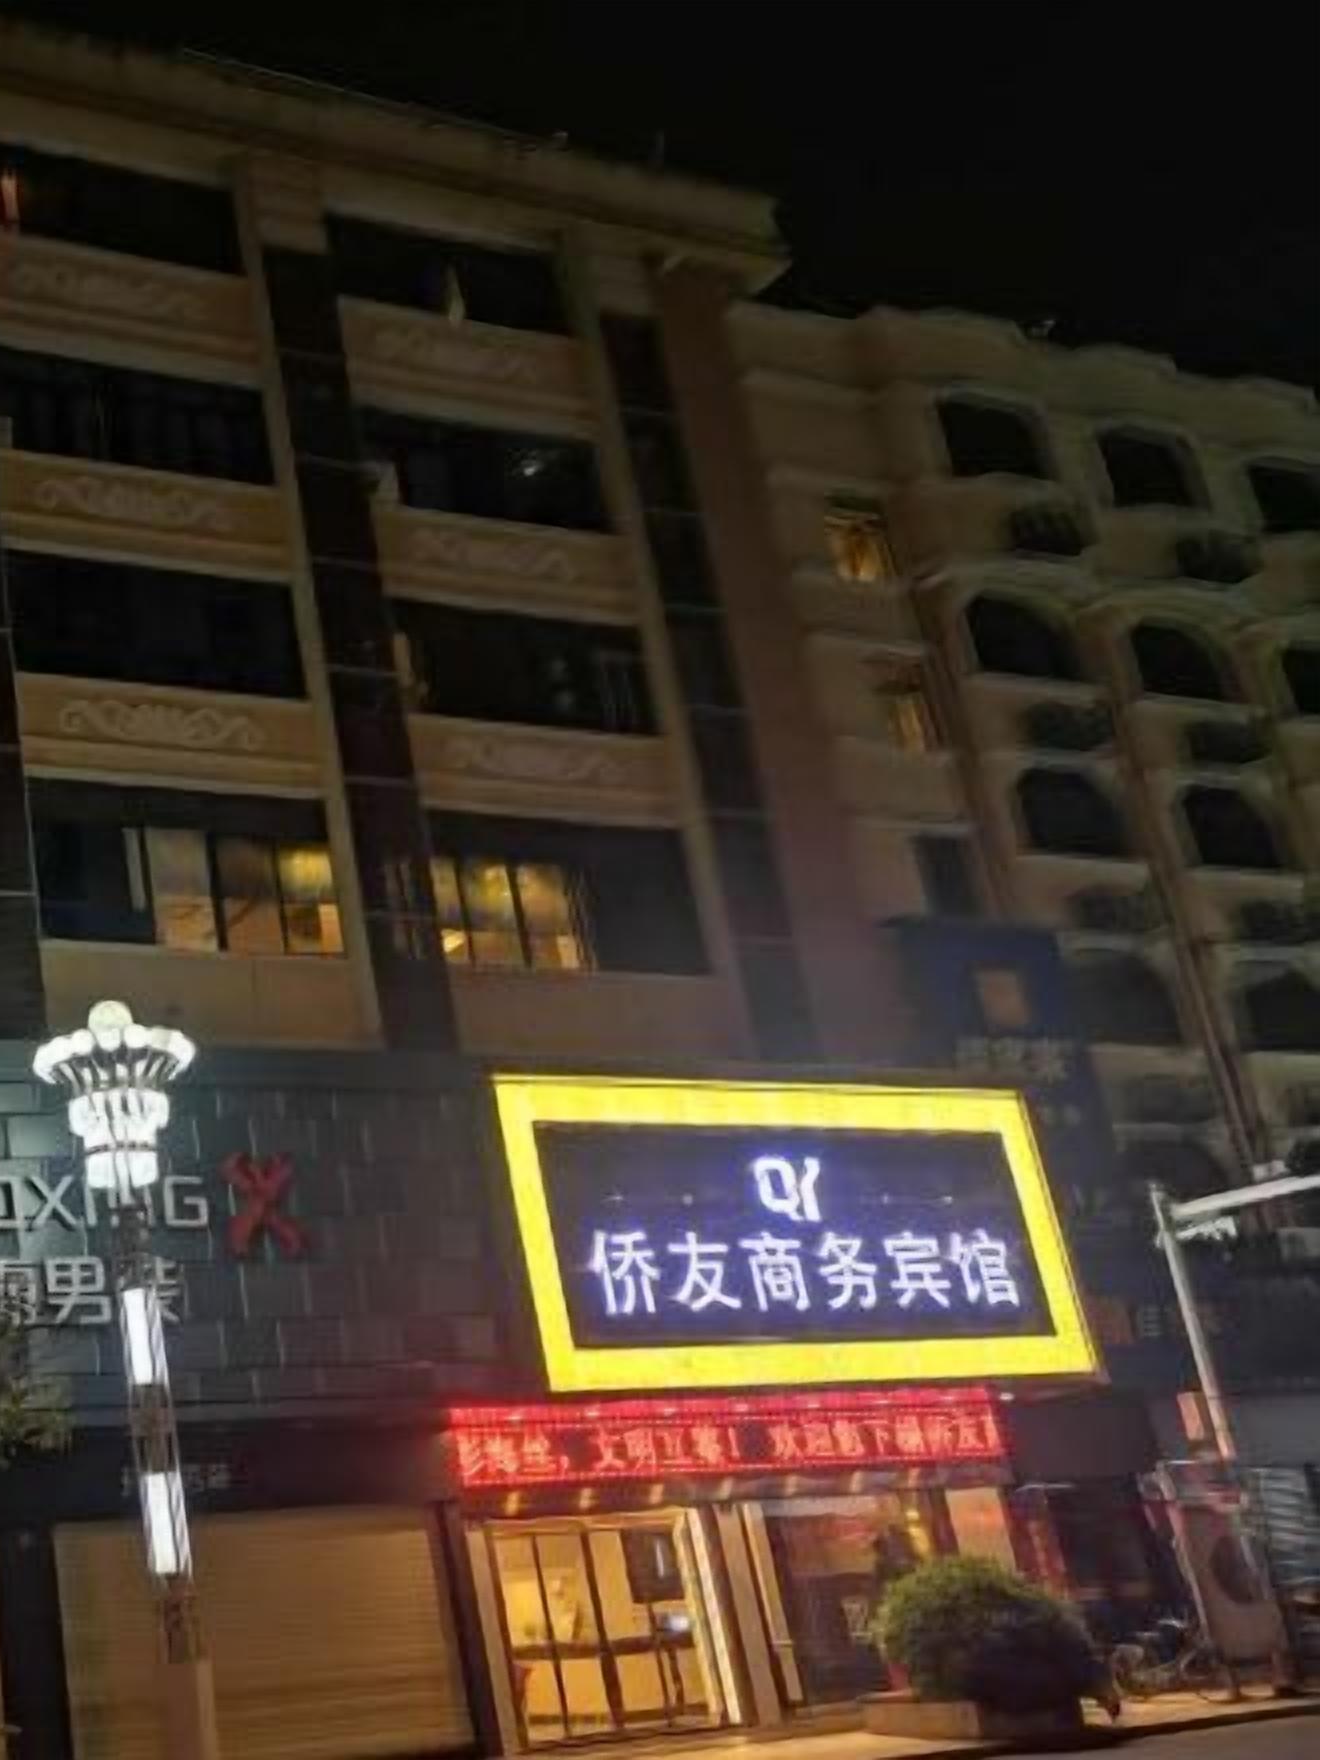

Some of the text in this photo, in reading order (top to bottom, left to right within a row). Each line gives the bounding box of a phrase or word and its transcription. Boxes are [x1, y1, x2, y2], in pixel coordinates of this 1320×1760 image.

[589, 1230, 1021, 1316] 侨友商务宾馆
